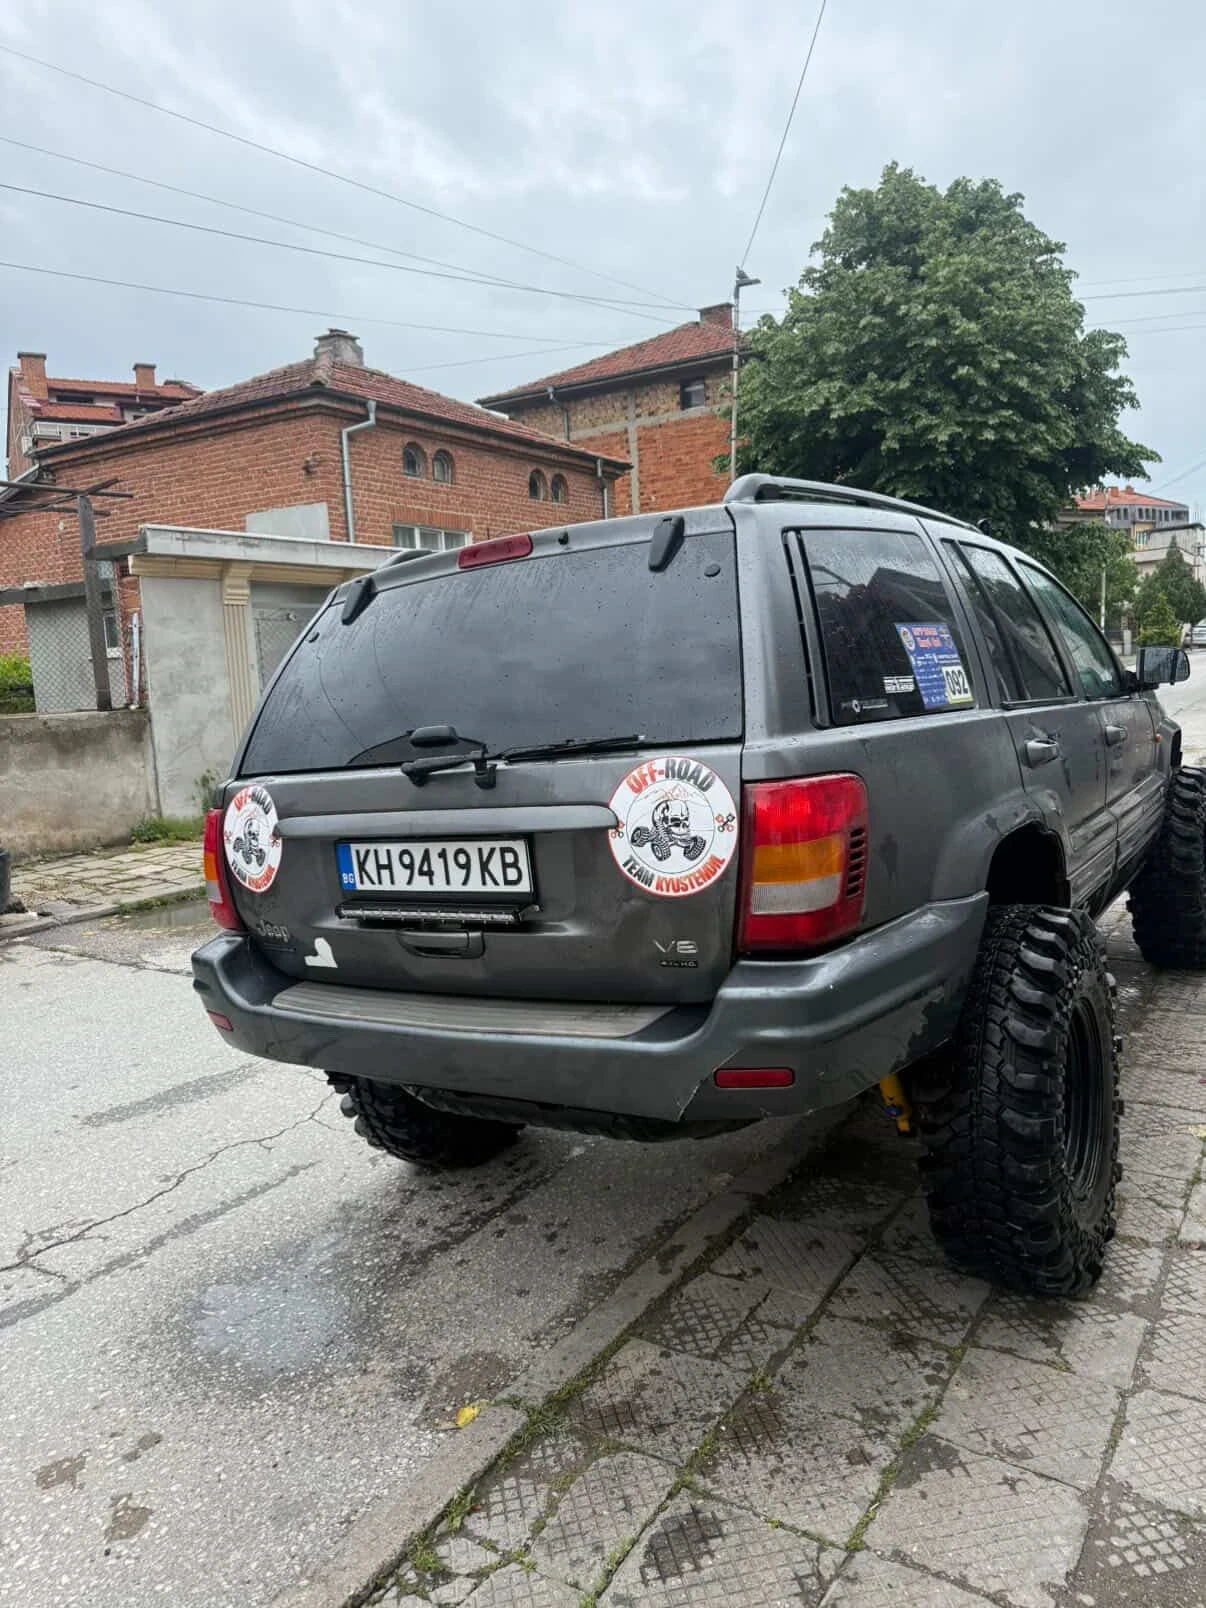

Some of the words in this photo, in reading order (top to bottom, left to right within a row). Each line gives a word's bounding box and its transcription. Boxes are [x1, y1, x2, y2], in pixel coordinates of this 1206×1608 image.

[946, 669, 969, 697] 092
[625, 758, 716, 795] OFF-ROAD
[342, 873, 354, 883] BG
[622, 854, 655, 888] TEAM
[257, 919, 290, 943] Jeep
